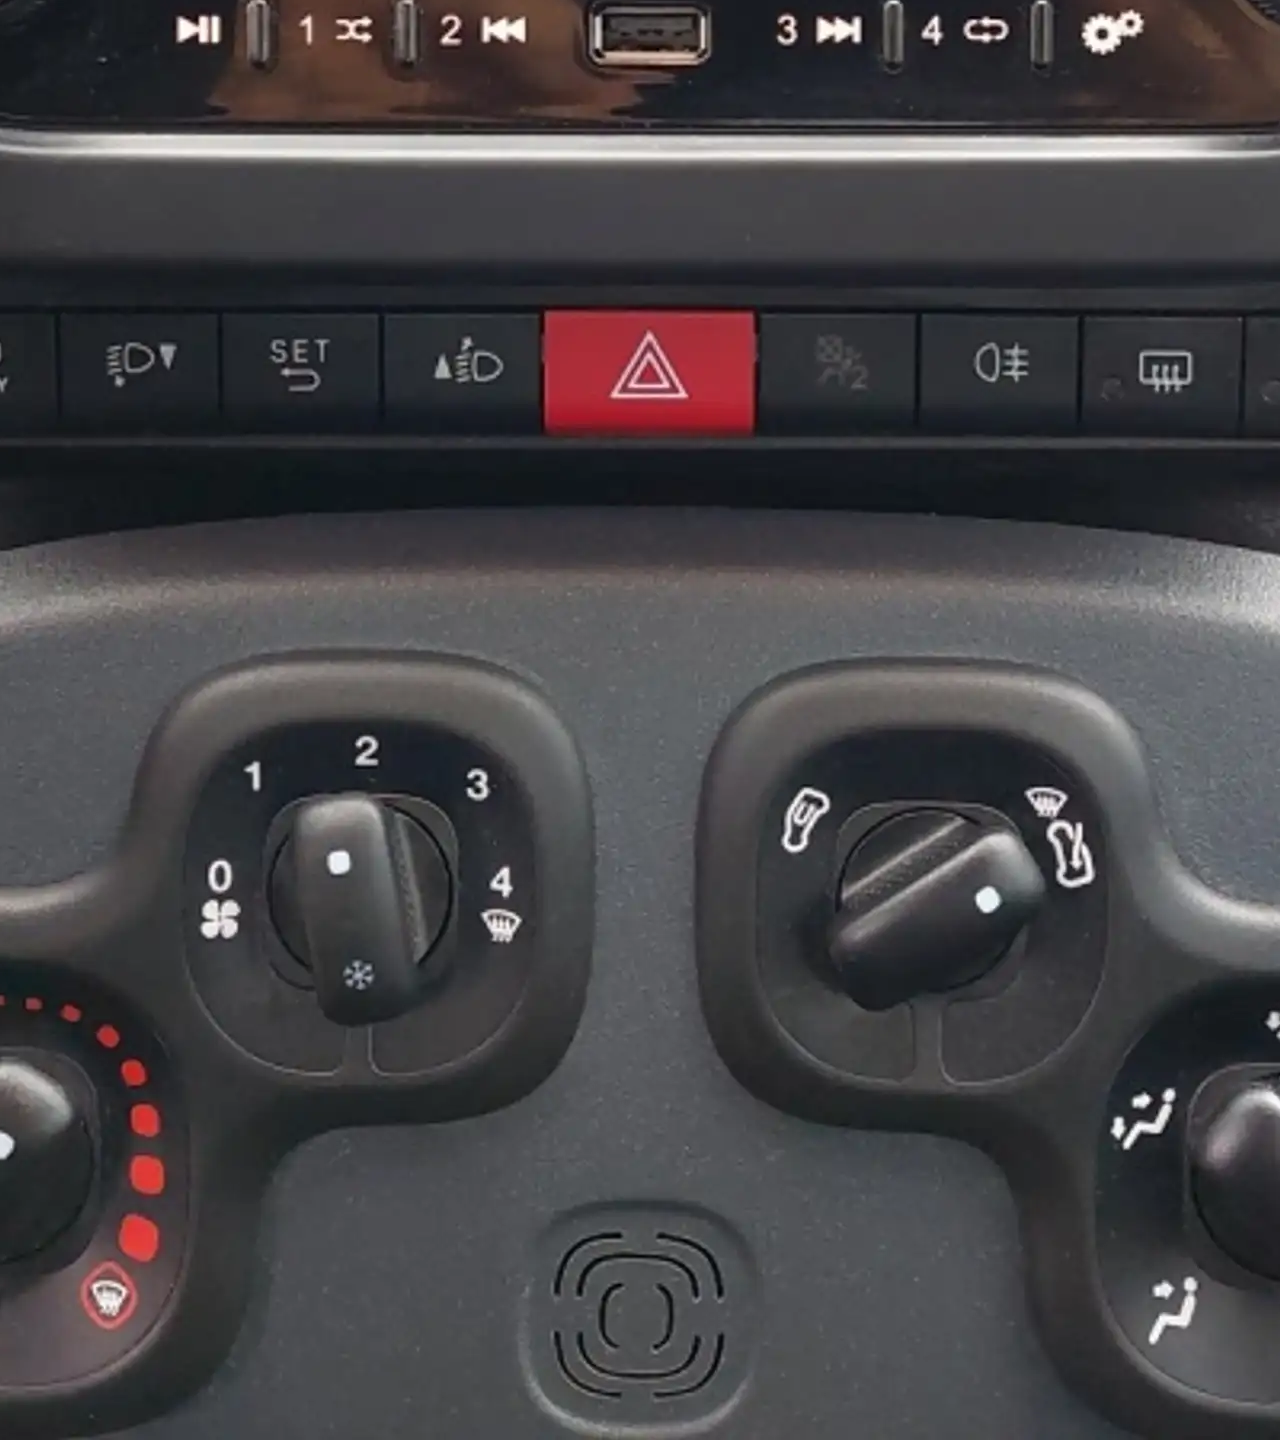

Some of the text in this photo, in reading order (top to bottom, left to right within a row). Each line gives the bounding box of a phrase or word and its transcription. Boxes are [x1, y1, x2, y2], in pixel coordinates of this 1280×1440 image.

[299, 16, 313, 44] 1
[440, 15, 462, 45] 2
[777, 15, 798, 45] 3
[921, 16, 943, 45] 4
[270, 338, 330, 364] SET
[355, 735, 379, 766] 2
[244, 761, 261, 791] 1
[466, 768, 490, 801] 3
[207, 859, 233, 893] 0
[489, 866, 514, 898] 4
